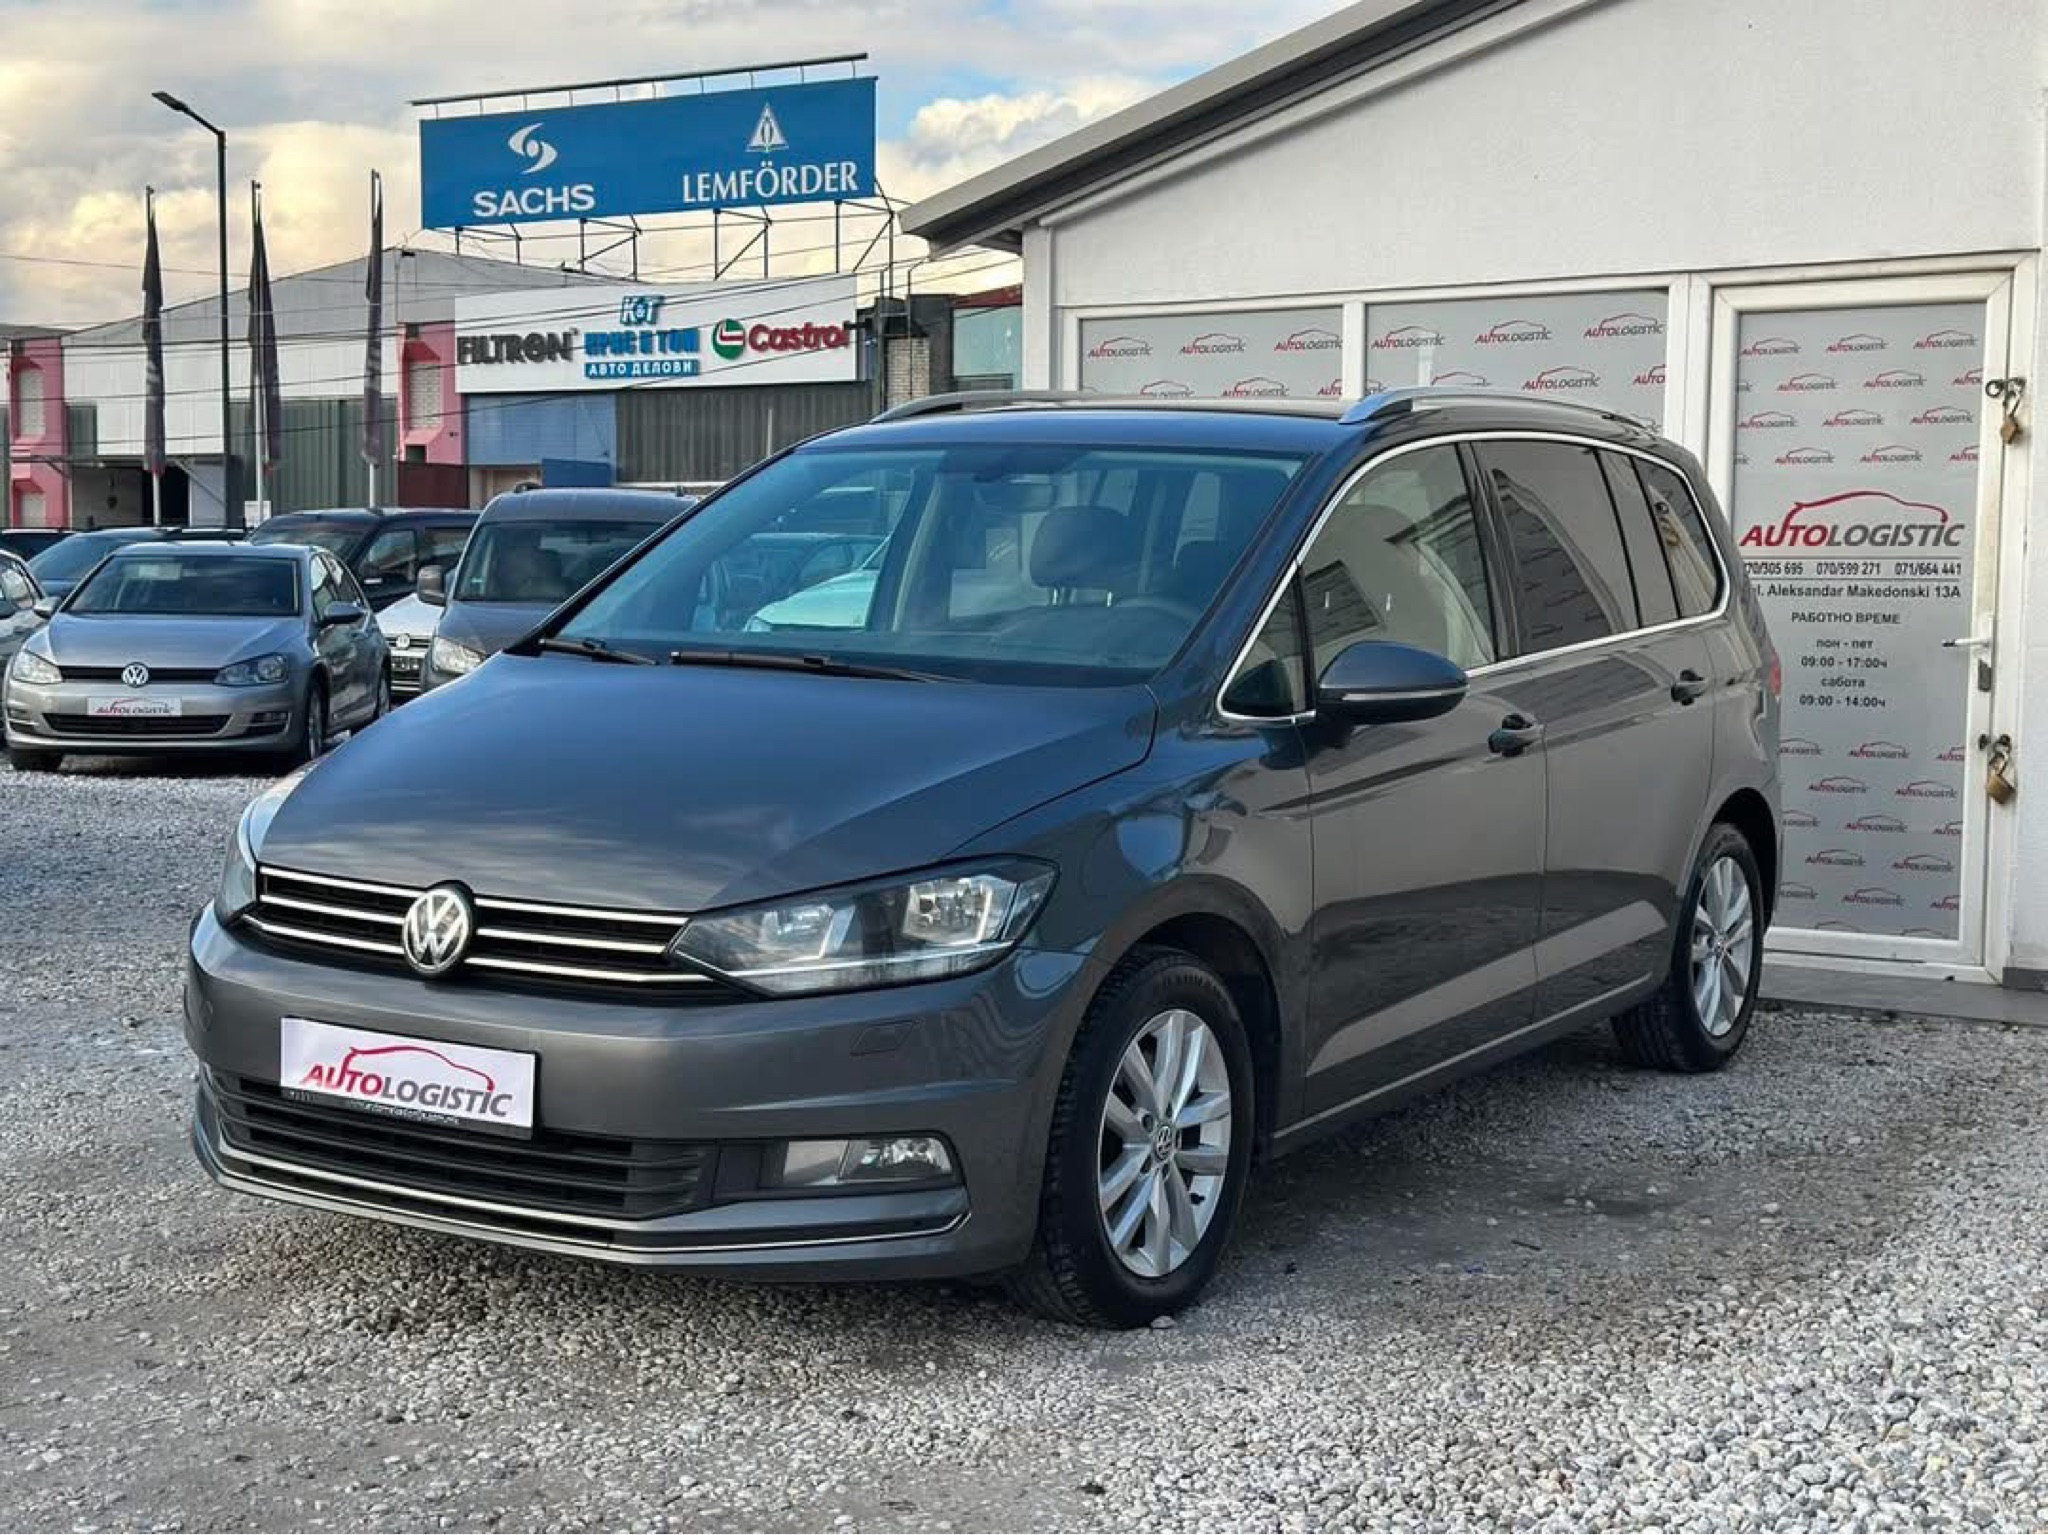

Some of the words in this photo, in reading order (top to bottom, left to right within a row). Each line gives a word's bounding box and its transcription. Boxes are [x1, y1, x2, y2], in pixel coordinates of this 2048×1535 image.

[683, 161, 859, 203] LEMFÖRDER
[473, 184, 596, 217] SACHS
[748, 319, 851, 353] Castrol
[457, 332, 574, 365] FILTRON
[588, 363, 627, 377] АВТО
[631, 361, 692, 378] ДЕЛОВИ
[1740, 524, 1966, 547] AUTOLOGISTIC
[1816, 562, 1860, 576] 070/599
[1861, 562, 1881, 576] 271
[1767, 584, 1844, 598] Aleksandar
[1847, 584, 1930, 598] Makedonski
[1934, 585, 1961, 598] 13A
[1791, 612, 1852, 623] РАБОТНО
[1856, 613, 1902, 625] ВРЕМЕ
[1816, 639, 1841, 649] пон
[1851, 640, 1874, 649] пет
[1801, 655, 1835, 667] 09:00
[1820, 676, 1866, 688] сабота
[1799, 695, 1833, 707] 09:00
[301, 1065, 513, 1117] AUTOLOGISTIC
